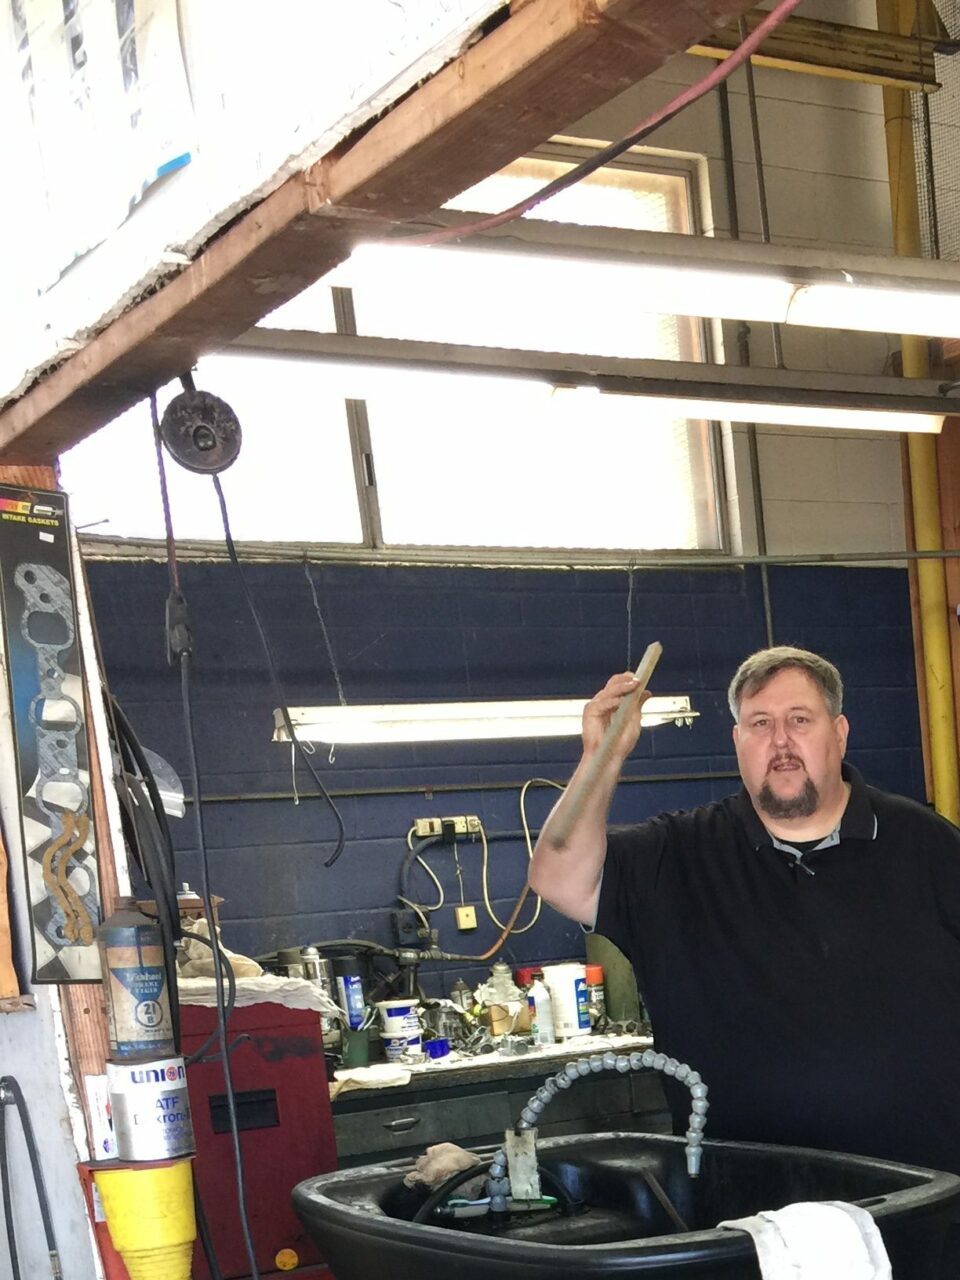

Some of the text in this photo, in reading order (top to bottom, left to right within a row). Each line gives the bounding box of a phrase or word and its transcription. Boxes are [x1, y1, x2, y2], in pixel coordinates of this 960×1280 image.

[28, 517, 59, 527] GASKETS
[143, 1003, 156, 1015] 21
[156, 1096, 179, 1110] ATF
